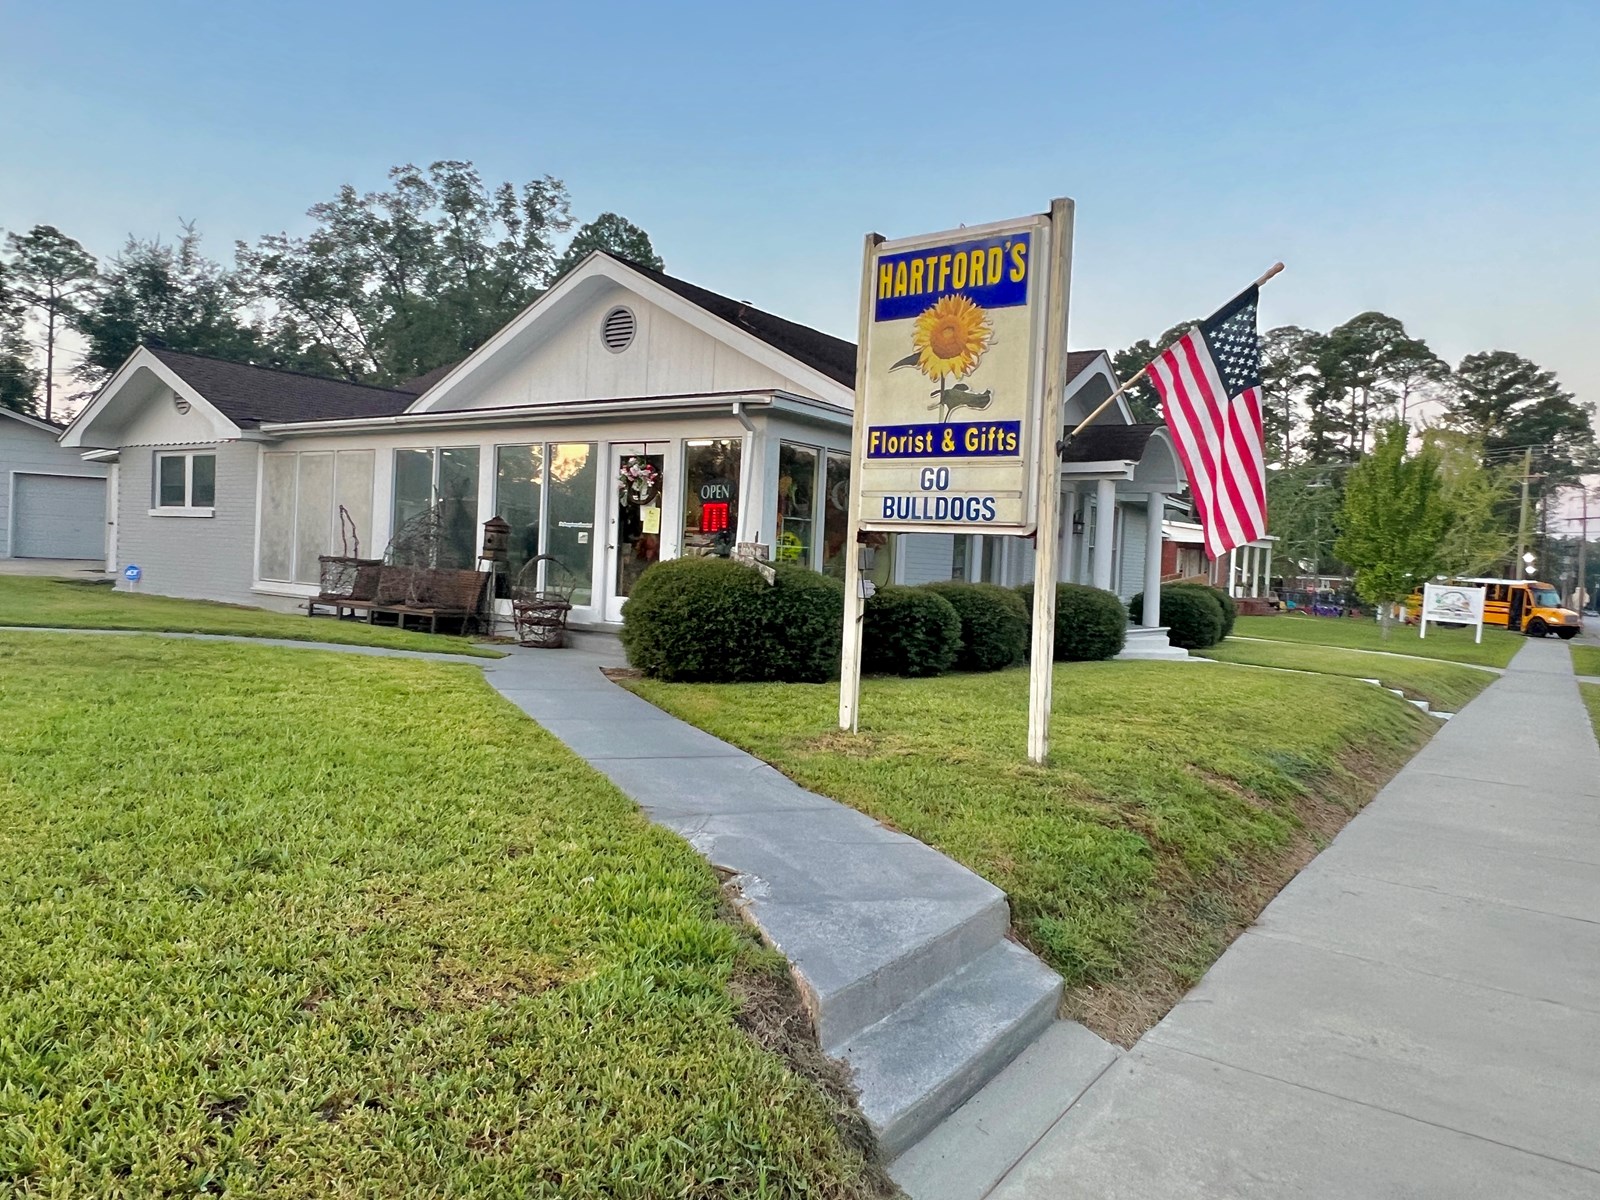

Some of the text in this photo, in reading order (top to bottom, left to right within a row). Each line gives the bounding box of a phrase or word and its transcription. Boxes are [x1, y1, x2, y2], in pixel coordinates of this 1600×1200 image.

[878, 241, 1027, 299] HARTFORD'S
[869, 426, 1017, 454] Florist & Gifts
[700, 484, 730, 499] OPEN
[920, 467, 949, 491] GO
[882, 496, 996, 521] BULLDOGS
